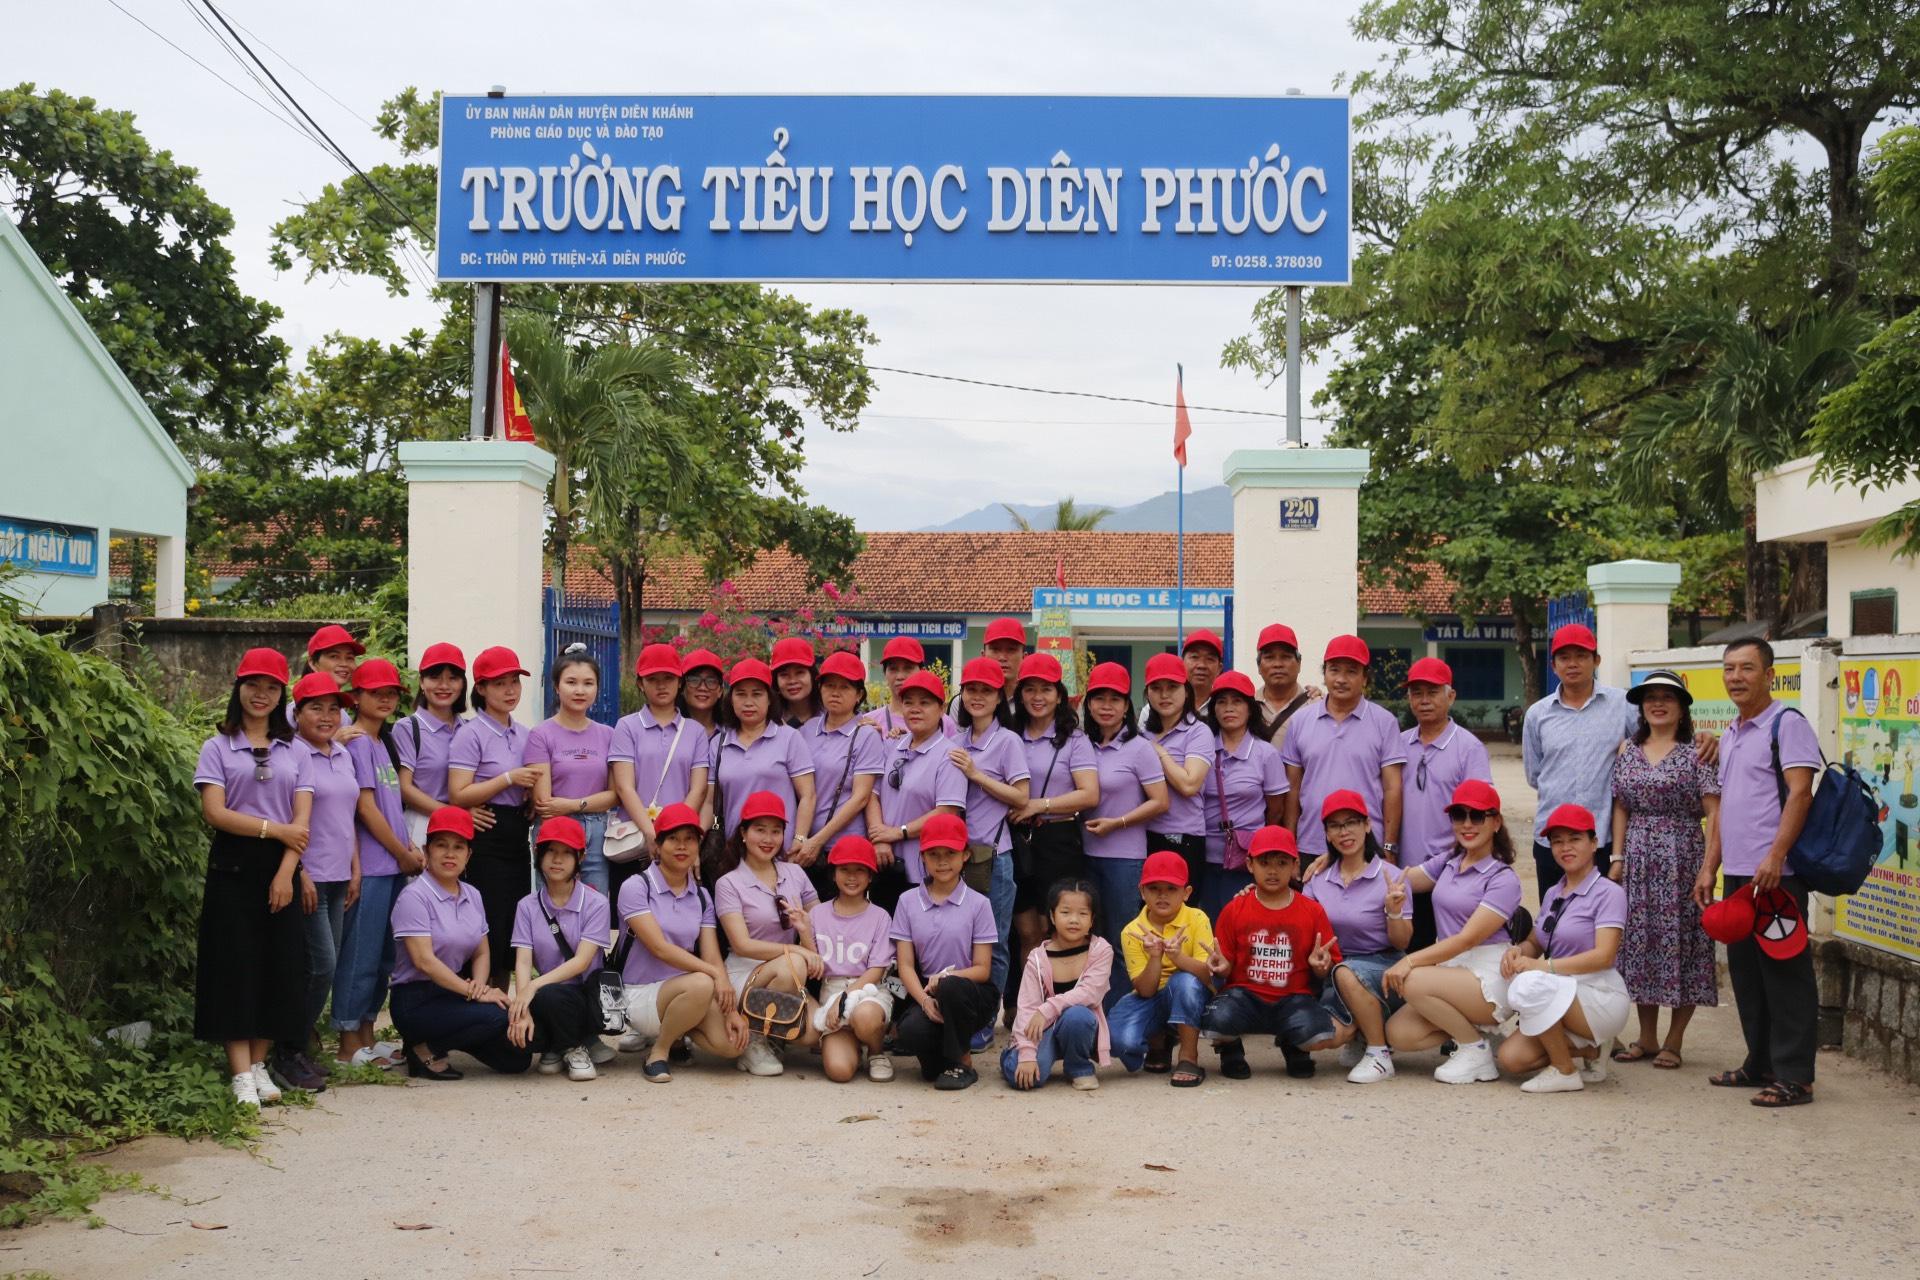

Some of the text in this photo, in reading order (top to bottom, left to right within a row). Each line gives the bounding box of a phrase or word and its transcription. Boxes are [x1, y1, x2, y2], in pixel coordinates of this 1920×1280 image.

[466, 103, 694, 121] ỦY BAN NHÂN DÂN HUYỆN DIÊN KHÁNH
[491, 124, 664, 141] PHÒNG GIÁO DỤC VÀ ĐÀO TẠO
[460, 126, 1328, 248] TRƯỜNG TIỂU HỌC DIÊN PHƯỚC
[485, 249, 517, 265] THÔN
[522, 249, 546, 265] PHÒ
[613, 249, 640, 265] DIÊN
[645, 248, 686, 265] PHƯỚC
[1284, 499, 1314, 518] 220
[69, 538, 92, 566] VUI
[1096, 593, 1141, 607] HỌC
[1148, 591, 1170, 606] LỄ
[878, 623, 896, 635] HỌC
[898, 623, 919, 633] SINH
[921, 622, 941, 634] TÍCH
[943, 623, 961, 636] CỰC
[1896, 873, 1913, 887] HỌC
[1250, 947, 1293, 958] OVERHIT
[1250, 958, 1292, 969] OVERHIT
